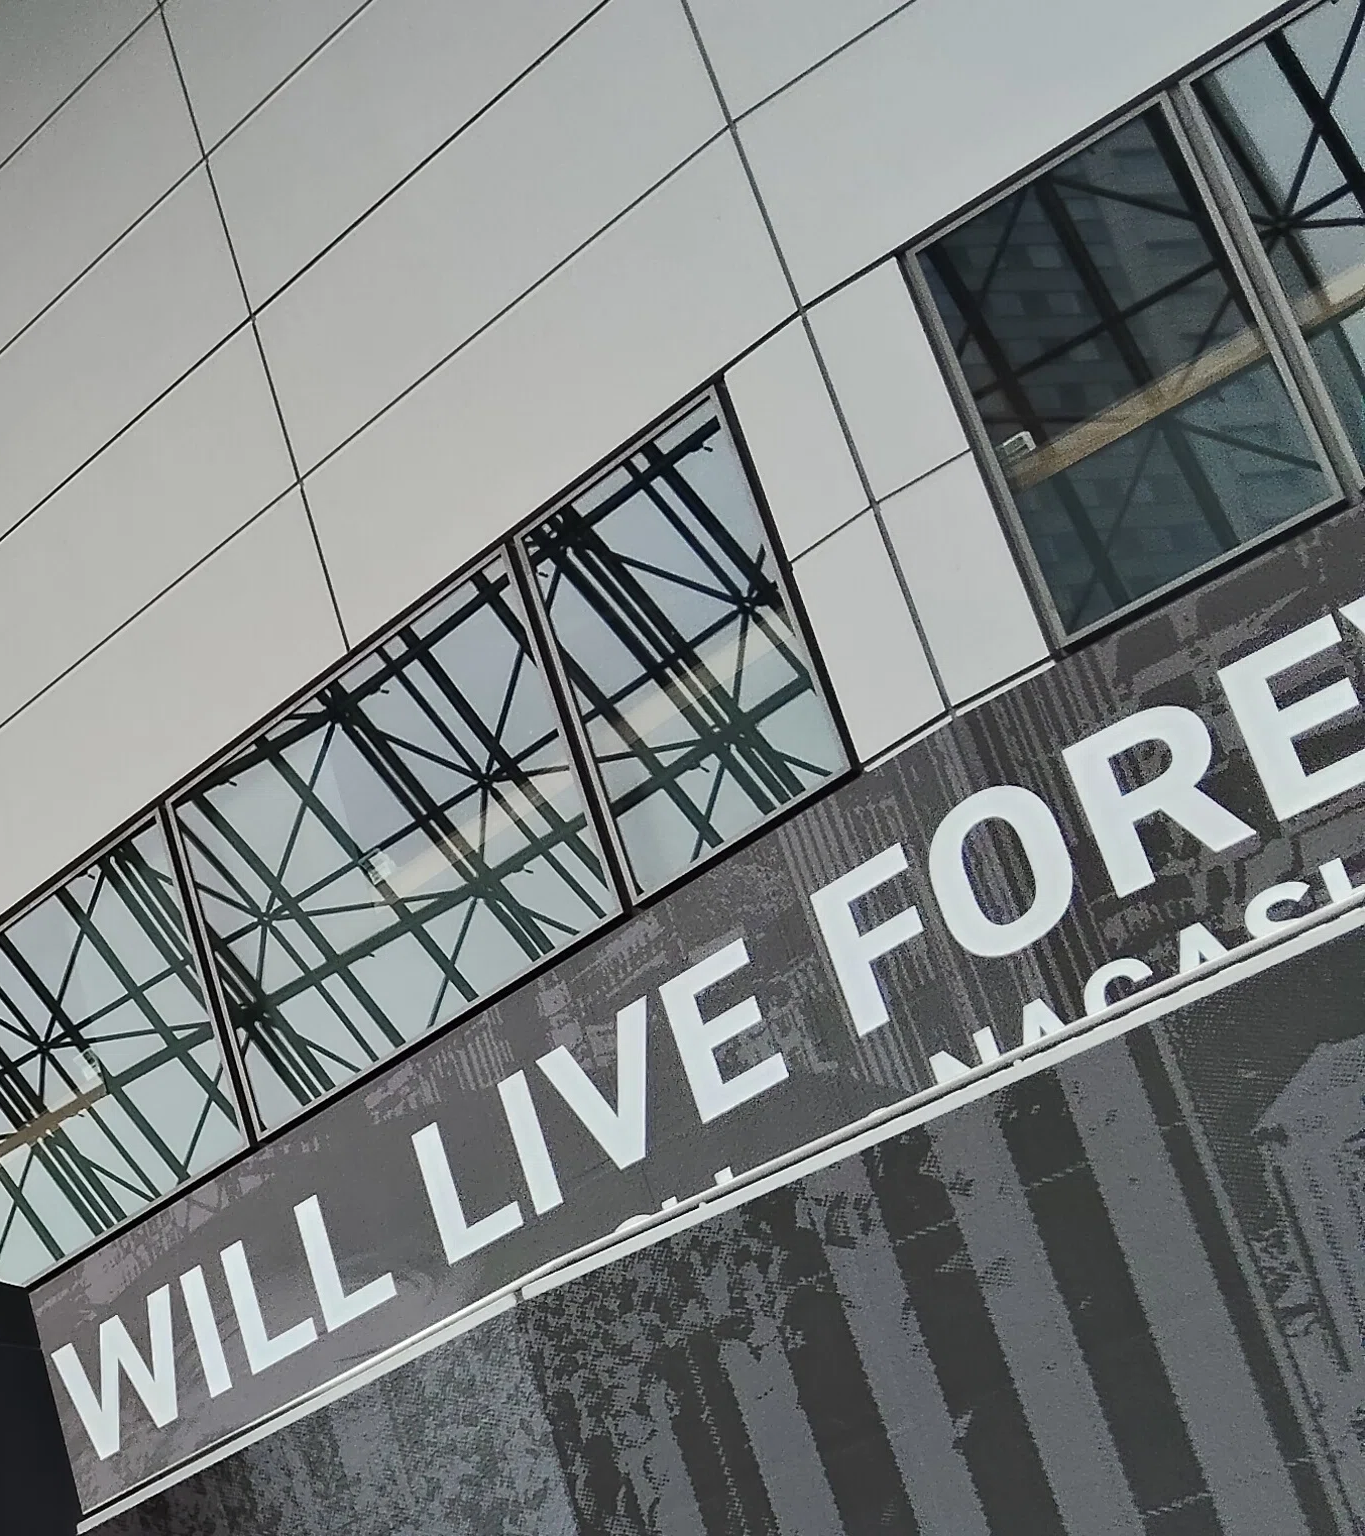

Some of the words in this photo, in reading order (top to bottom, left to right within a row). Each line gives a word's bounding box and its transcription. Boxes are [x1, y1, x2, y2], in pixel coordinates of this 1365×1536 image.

[51, 1194, 397, 1460] WILL
[411, 937, 789, 1265] LIVE
[810, 597, 1365, 1038] FORE
